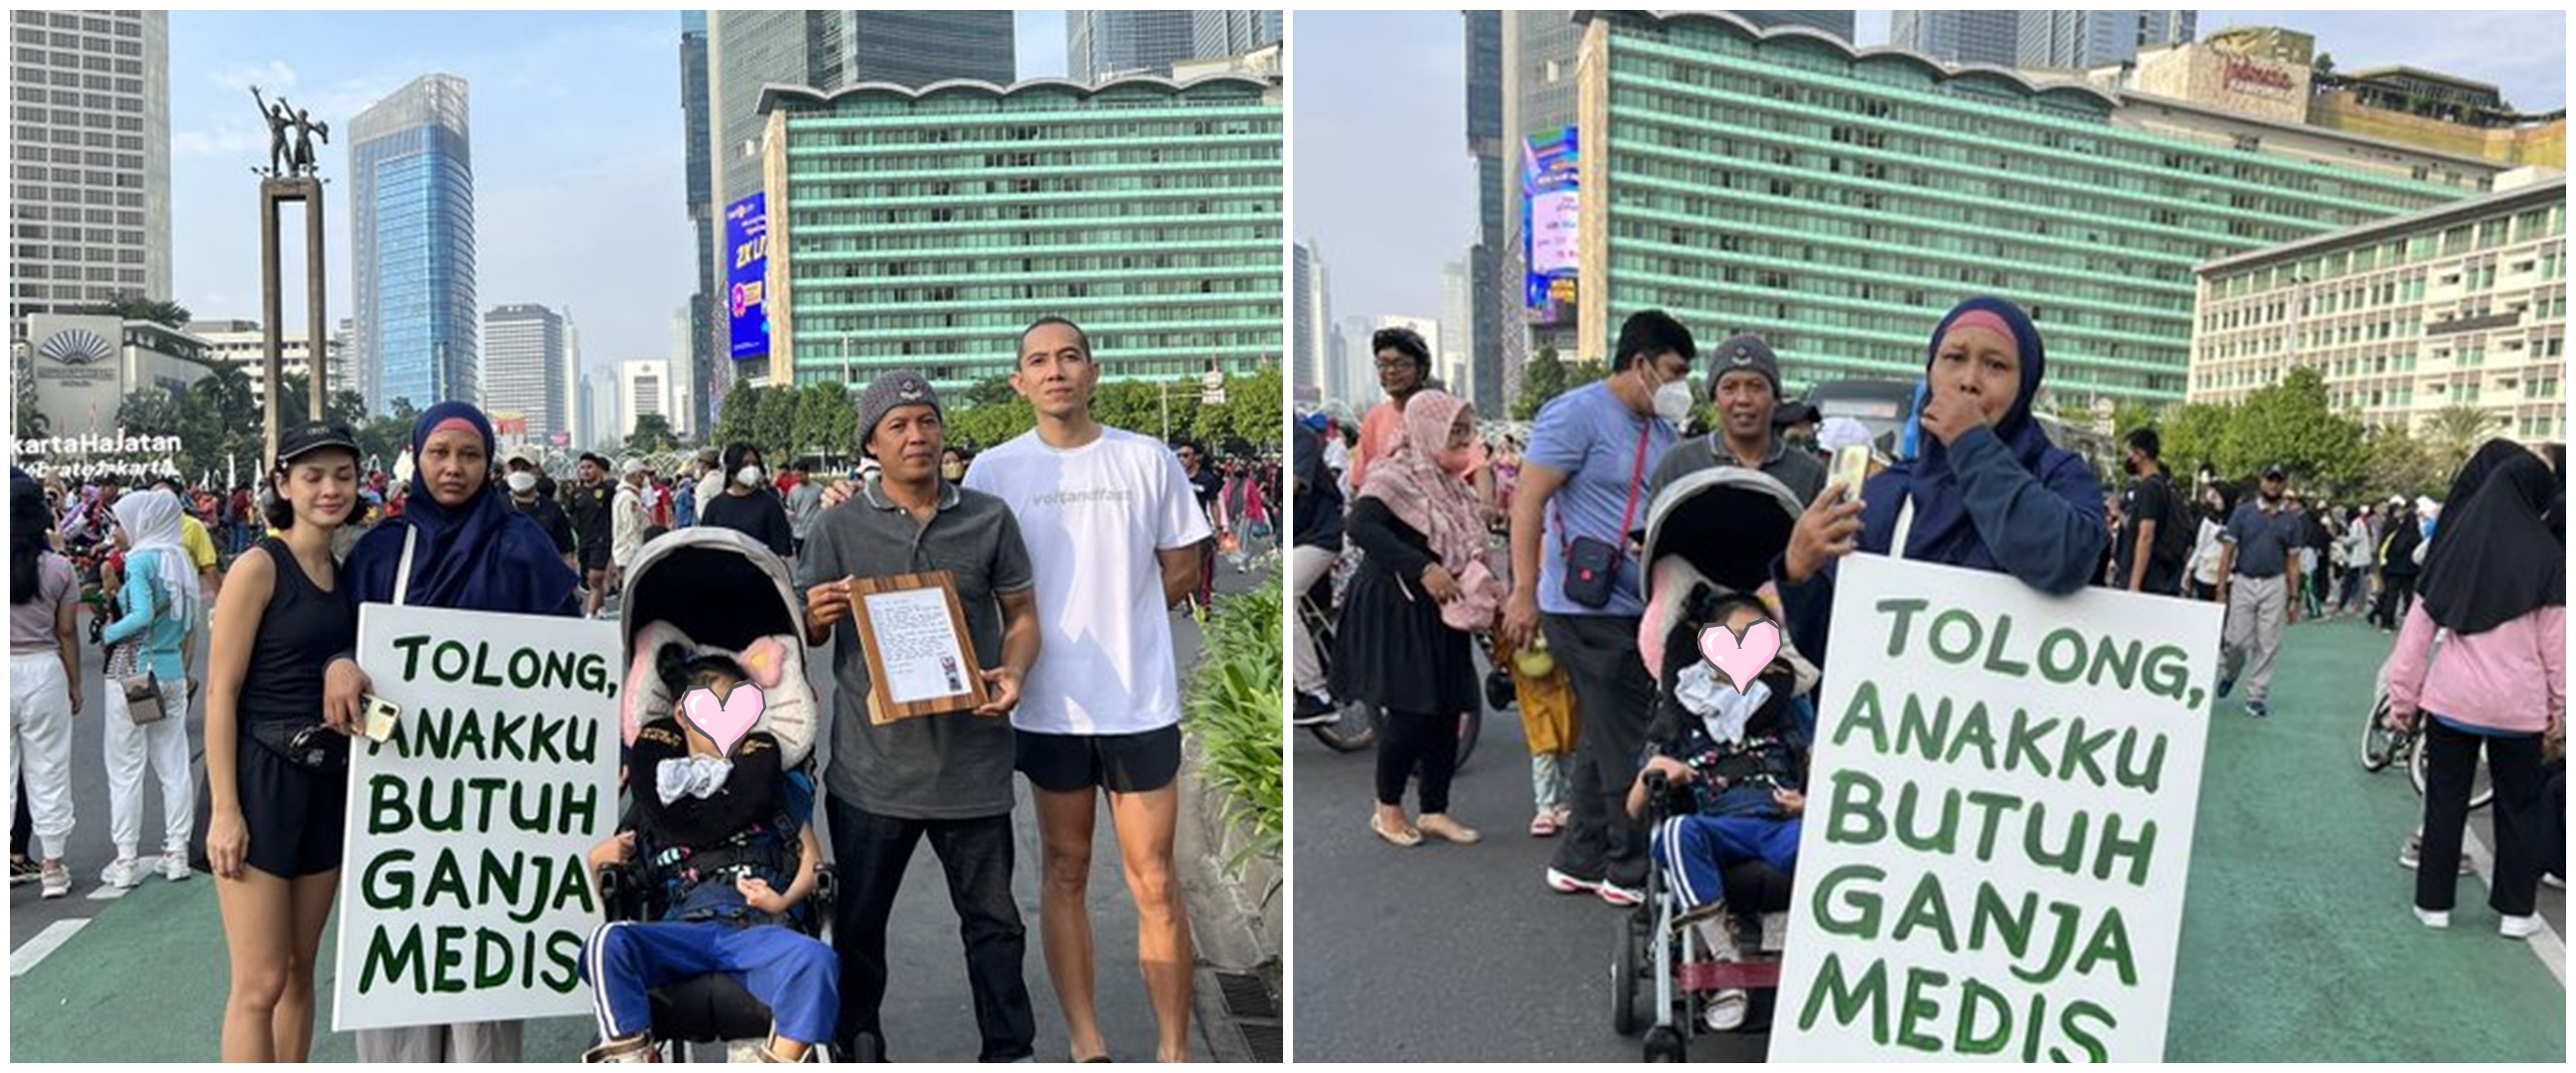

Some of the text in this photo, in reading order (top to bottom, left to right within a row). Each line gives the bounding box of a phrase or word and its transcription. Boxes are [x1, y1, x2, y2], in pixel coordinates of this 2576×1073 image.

[393, 635, 618, 699] TOLONG,
[1877, 599, 2205, 709] TOLONG,
[1833, 682, 2168, 795] ANAKKU
[368, 774, 599, 836] BUTUH
[1826, 767, 2158, 891] BUTUH
[361, 846, 594, 924] GANJA
[1812, 864, 2140, 992] GANJA
[358, 922, 592, 995] MEDIS
[1797, 952, 2117, 1063] MEDIS
